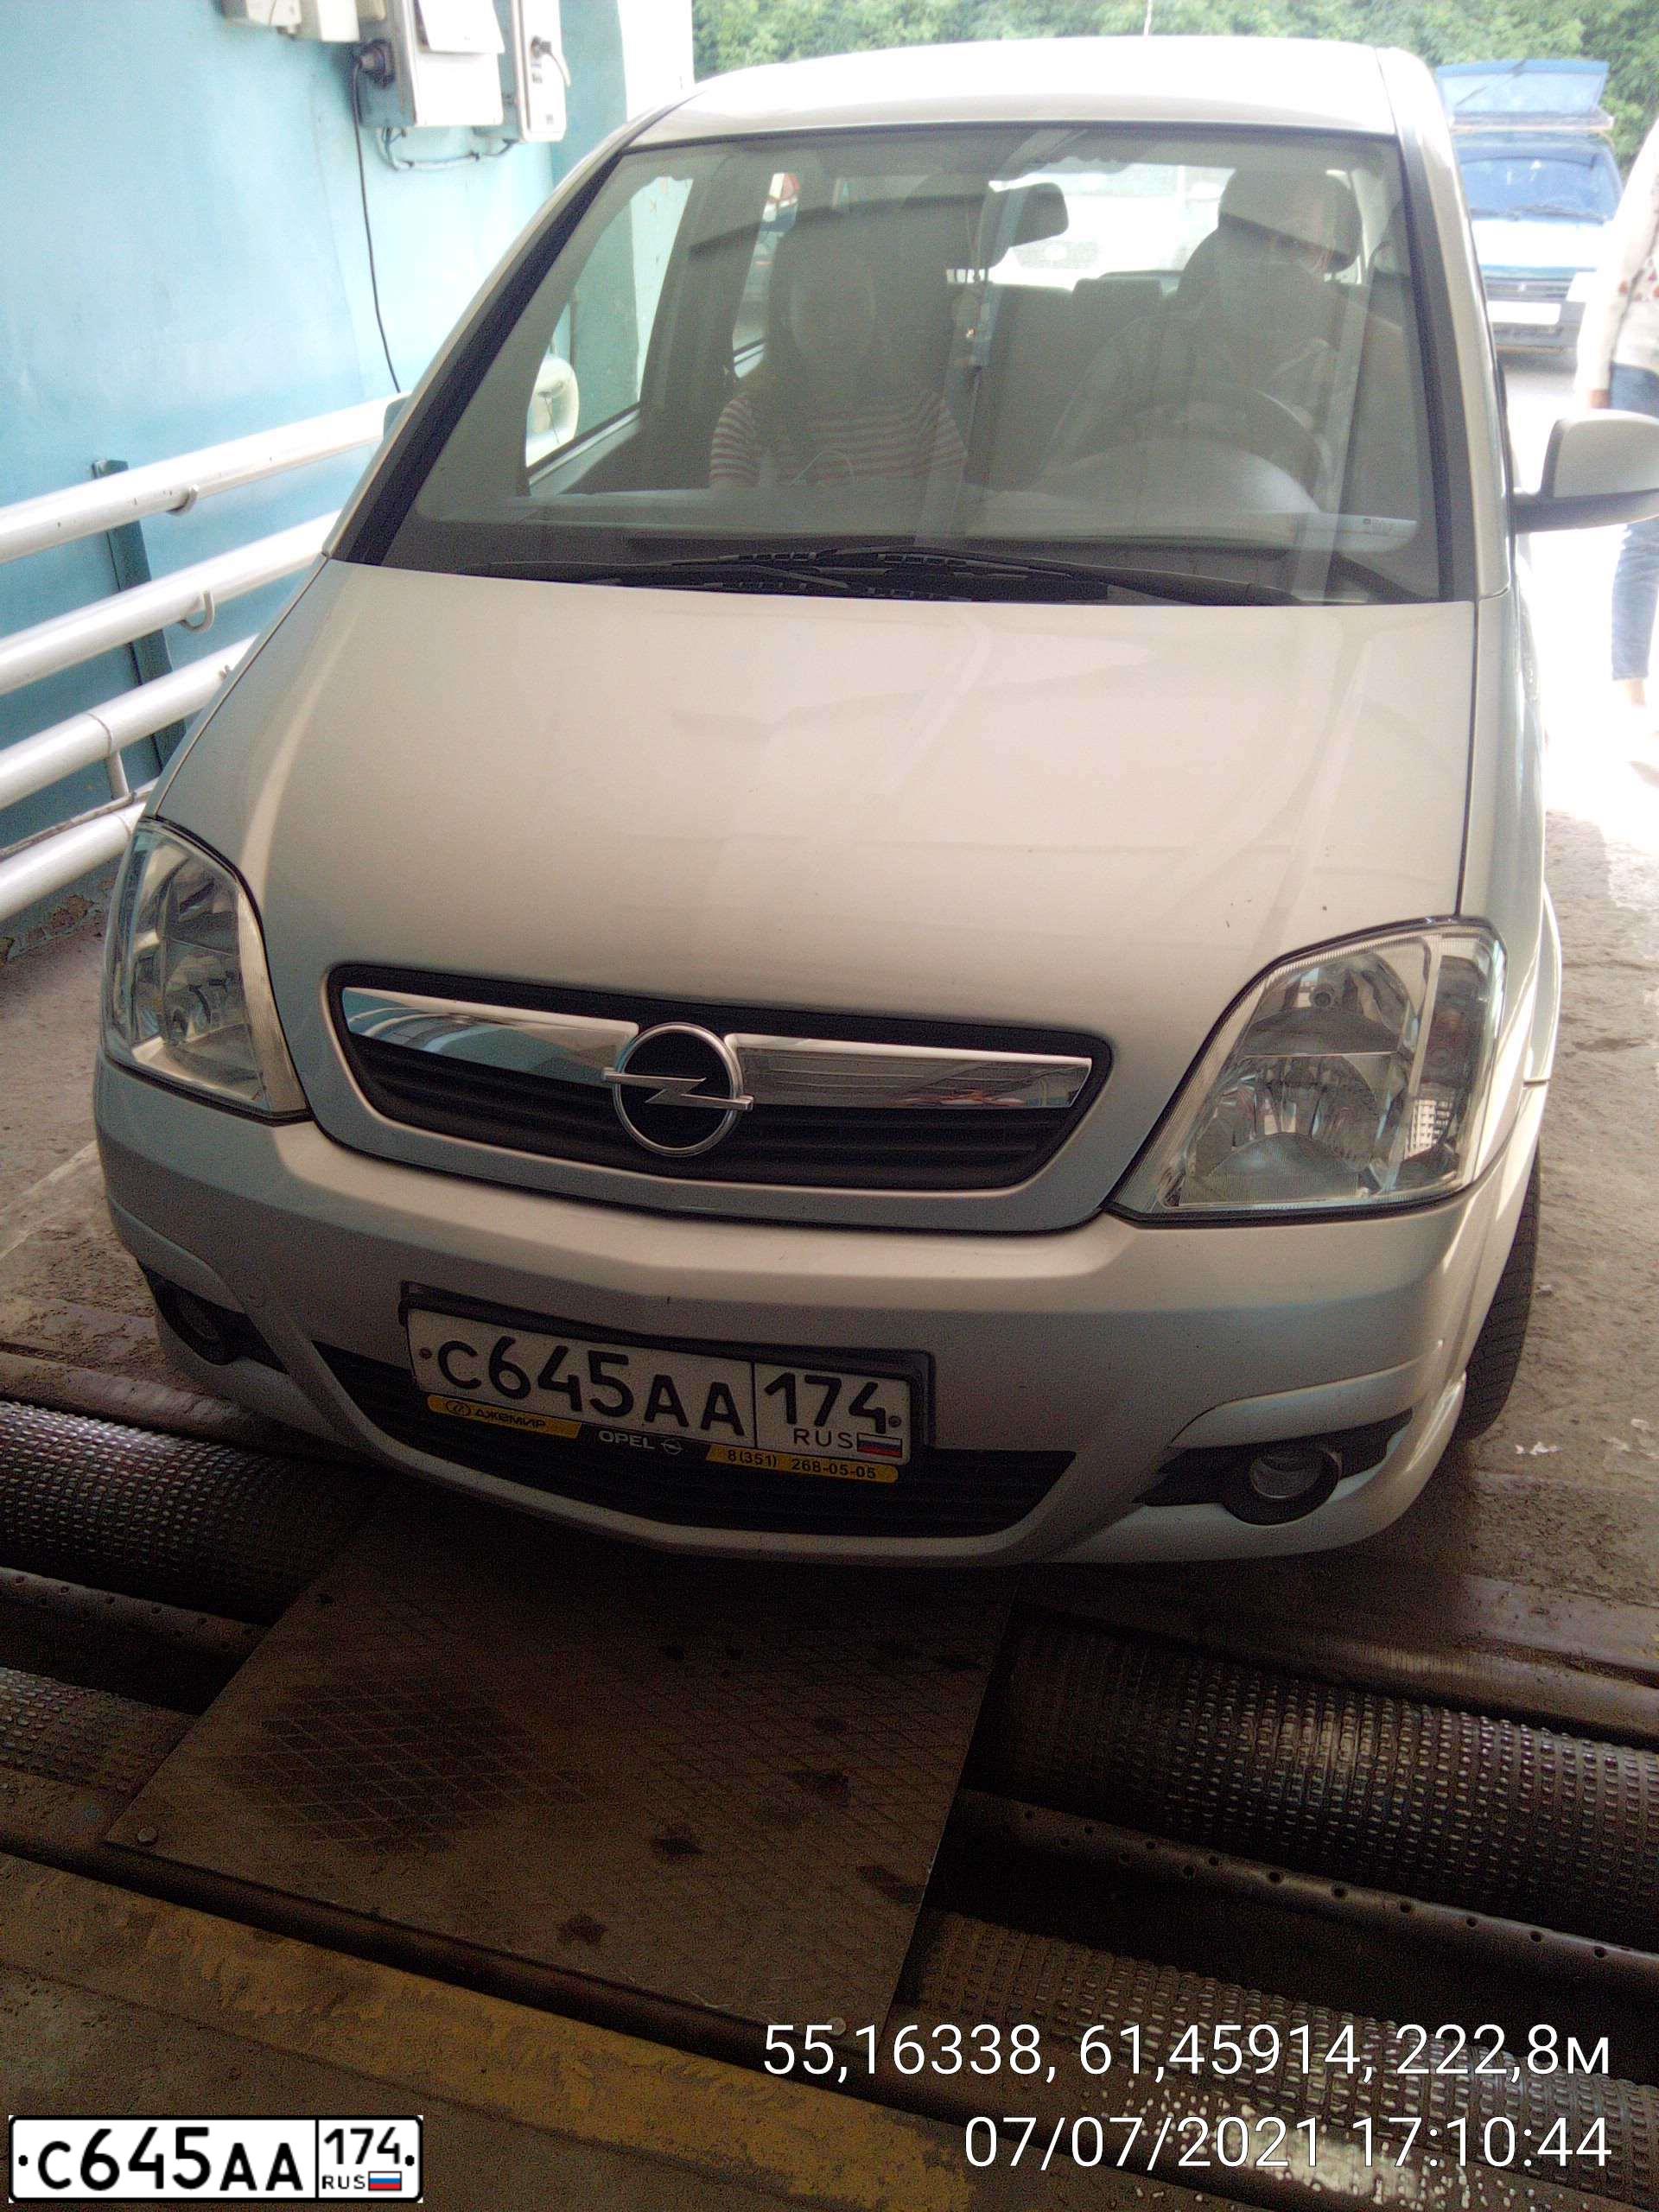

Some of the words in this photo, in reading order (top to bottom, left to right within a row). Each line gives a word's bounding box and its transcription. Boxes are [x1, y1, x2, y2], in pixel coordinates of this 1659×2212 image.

[438, 1336, 745, 1437] С645АА
[765, 1372, 887, 1434] 174
[598, 1429, 656, 1451] OPEL
[793, 1428, 854, 1449] RUS
[727, 1448, 778, 1468] 8(351)
[791, 1458, 876, 1479] 268-05-05
